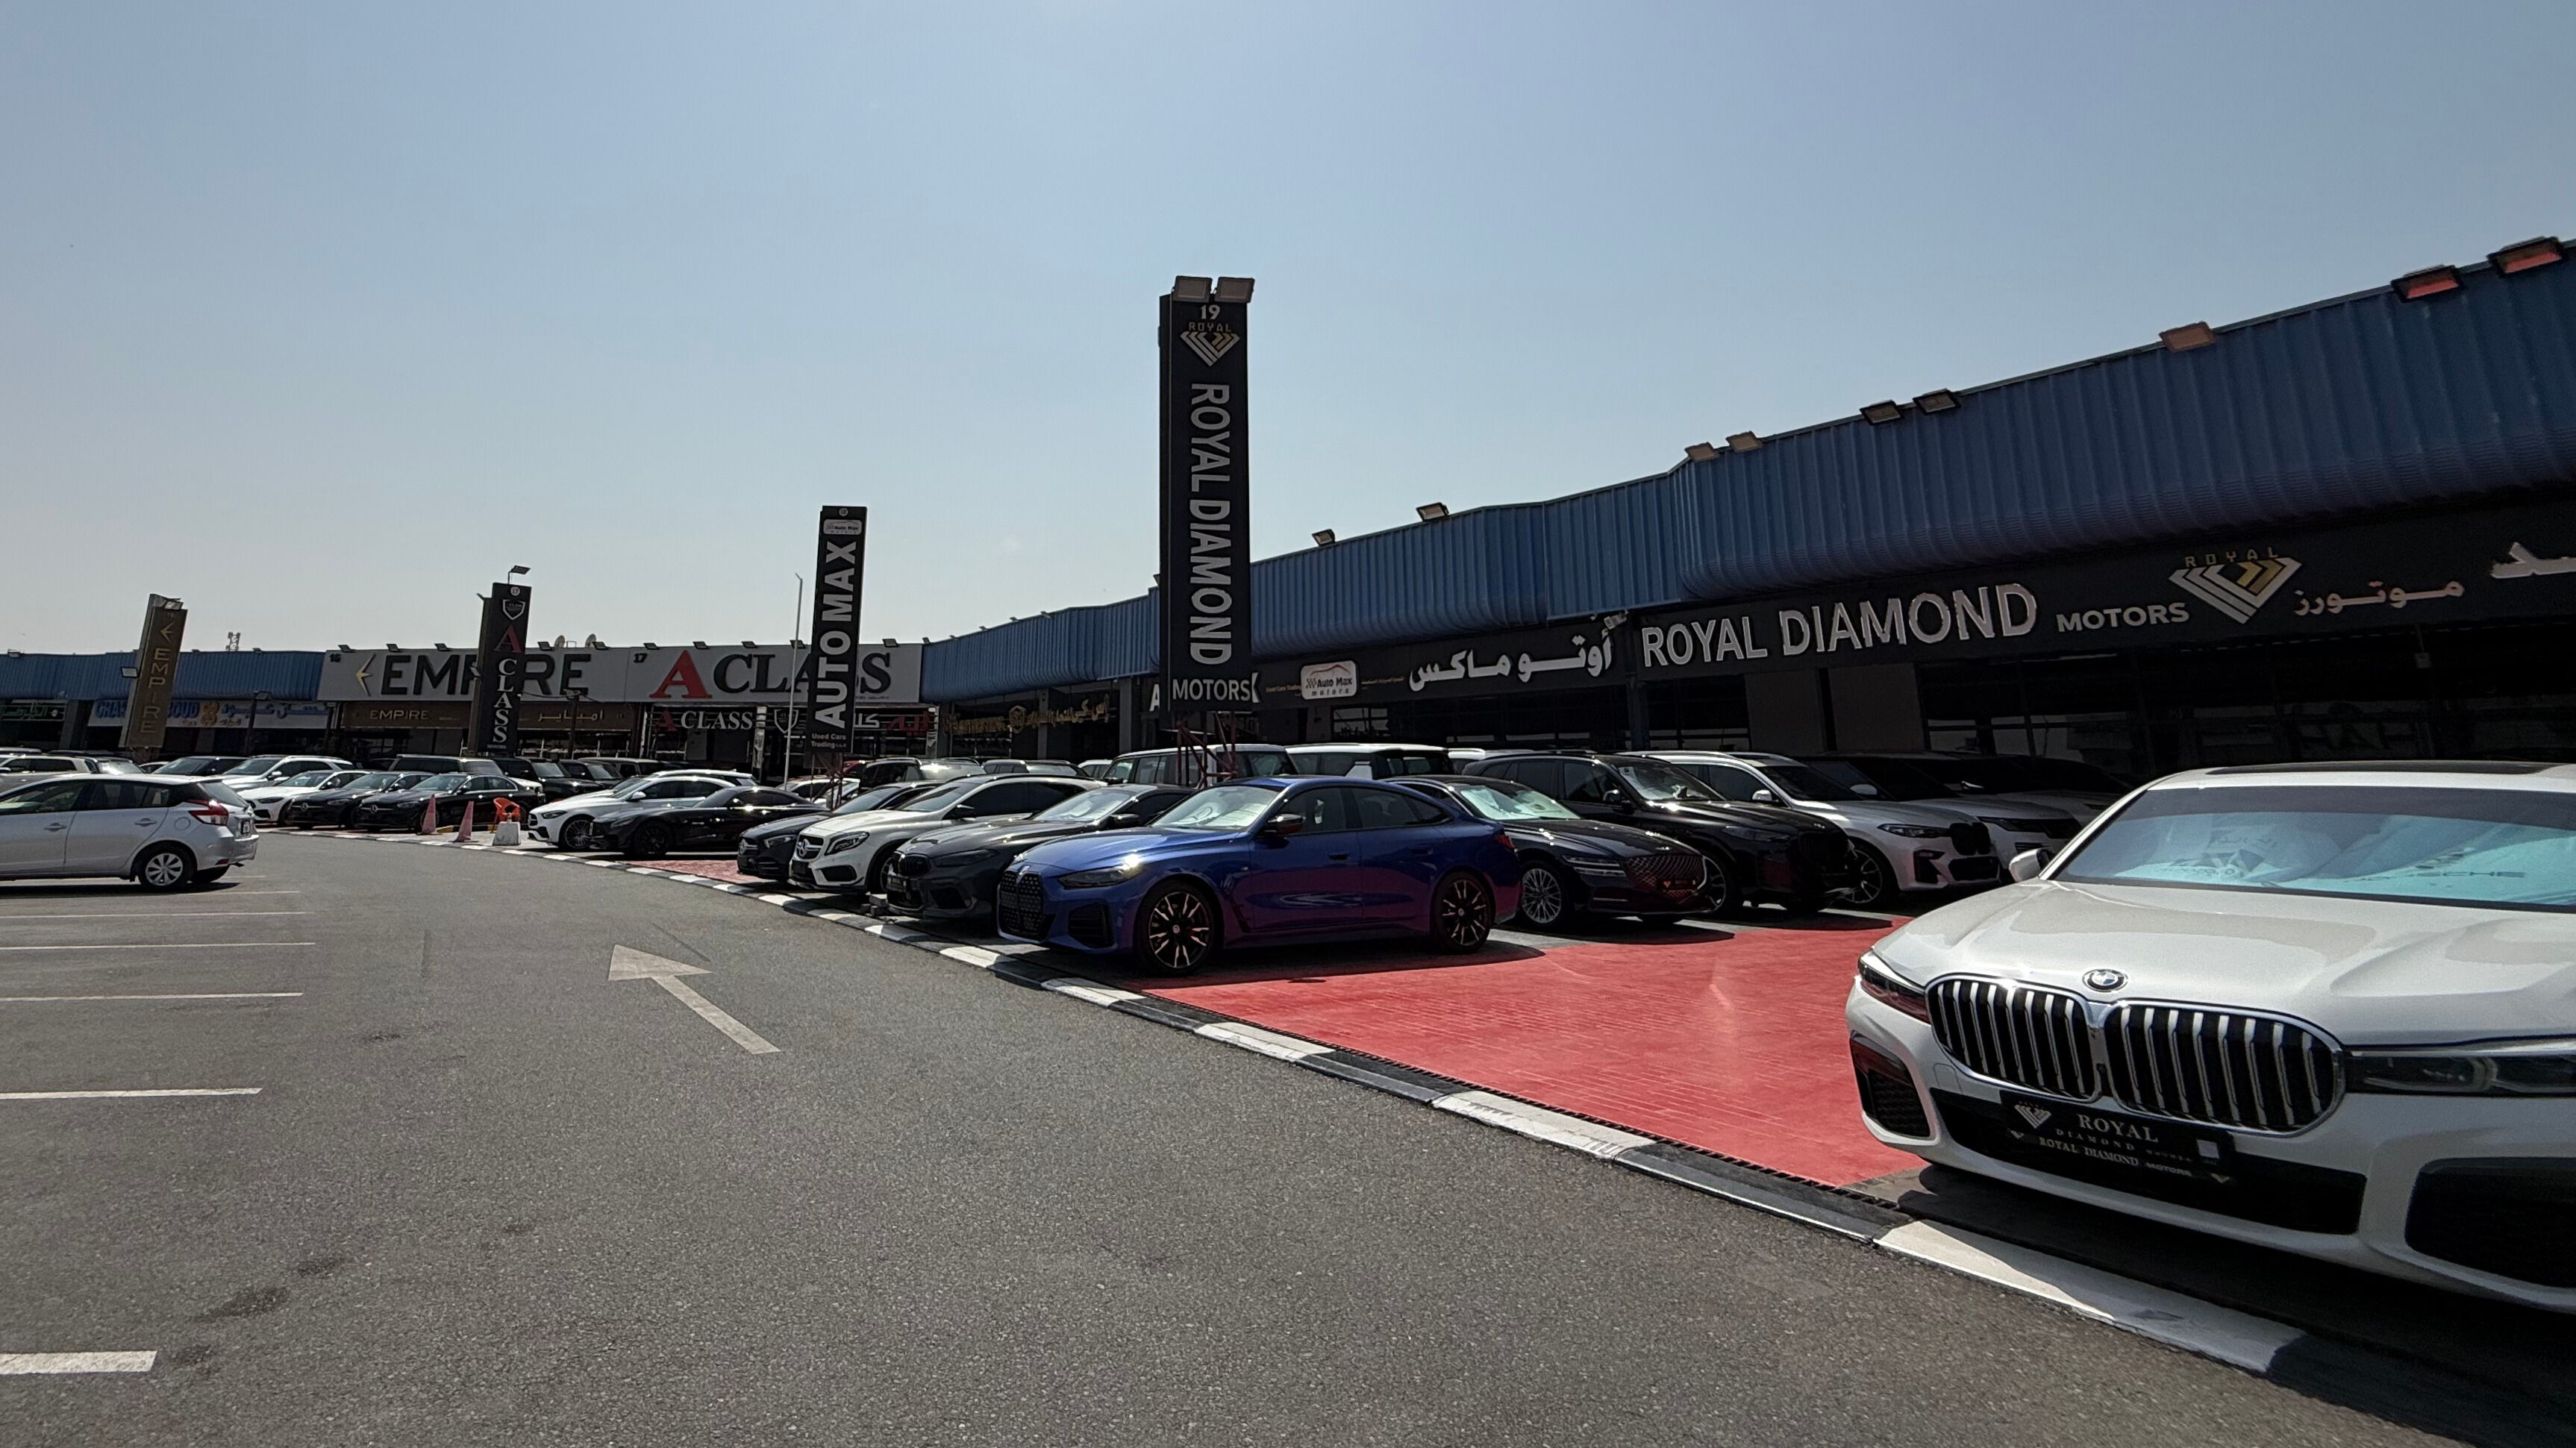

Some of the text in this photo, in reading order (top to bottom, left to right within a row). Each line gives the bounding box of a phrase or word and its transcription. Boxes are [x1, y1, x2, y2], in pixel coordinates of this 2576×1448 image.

[1189, 322, 1232, 332] ROYAL
[1201, 304, 1221, 320] 19
[1189, 383, 1233, 665] ROYAL DIAMOND
[2185, 546, 2278, 568] ROYAL
[2293, 580, 2466, 616] موتورز
[493, 624, 523, 654] A
[815, 540, 857, 729] AUTO MAX
[1642, 583, 2190, 668] ROYAL DIAMOND MOTORS
[633, 653, 648, 663] 17
[1408, 627, 1613, 692] أوتو ماكس
[649, 650, 891, 698] A CLAS
[1317, 678, 1334, 687] Auto
[1336, 677, 1353, 686] Max
[140, 648, 172, 733] EMPIRE
[492, 658, 518, 743] CLASS
[1172, 678, 1251, 701] MOTORS
[369, 709, 431, 721] EMPIRE
[653, 709, 679, 732] A
[681, 711, 753, 730] CLASS
[2056, 1128, 2136, 1151] DIAMOND
[2076, 1113, 2159, 1143] ROYAL
[2039, 1136, 2078, 1154] ROYAL
[2083, 1147, 2140, 1167] DIAMOND
